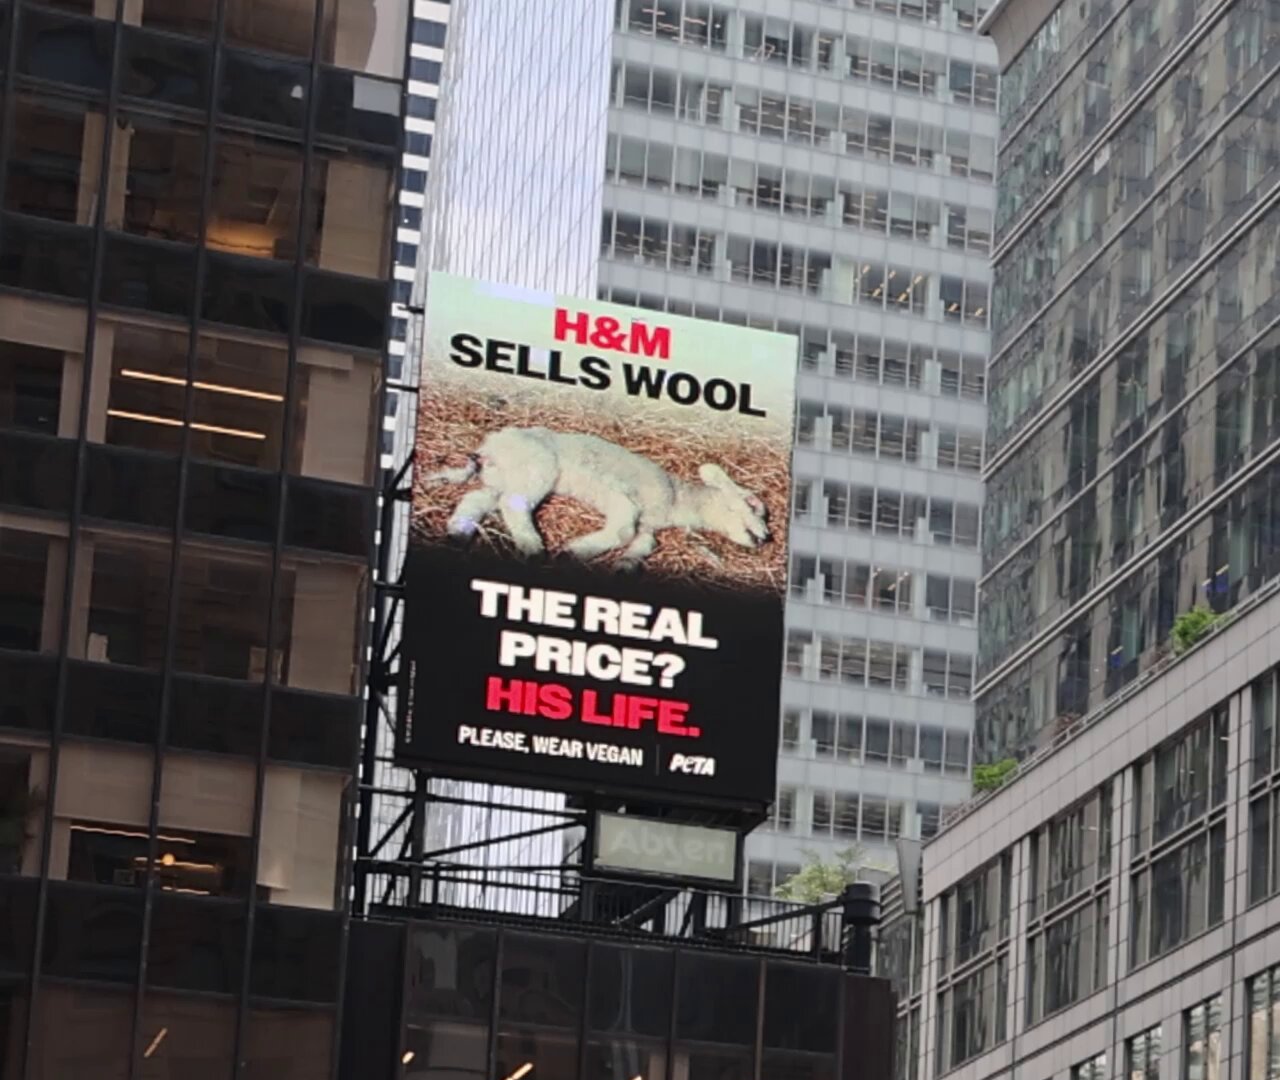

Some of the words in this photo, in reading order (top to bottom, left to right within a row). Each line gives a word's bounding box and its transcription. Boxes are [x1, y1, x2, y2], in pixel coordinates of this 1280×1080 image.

[553, 308, 672, 359] H&M
[450, 332, 611, 391] SELLS
[622, 363, 767, 418] WOOL
[471, 579, 577, 629] THE
[584, 596, 719, 650] REAL
[499, 630, 686, 689] PRICE?
[486, 675, 572, 720] HIS
[581, 692, 701, 738] LIFE.
[458, 724, 530, 753] PLEASE,
[532, 735, 583, 760] WEAR
[587, 741, 643, 767] VEGAN
